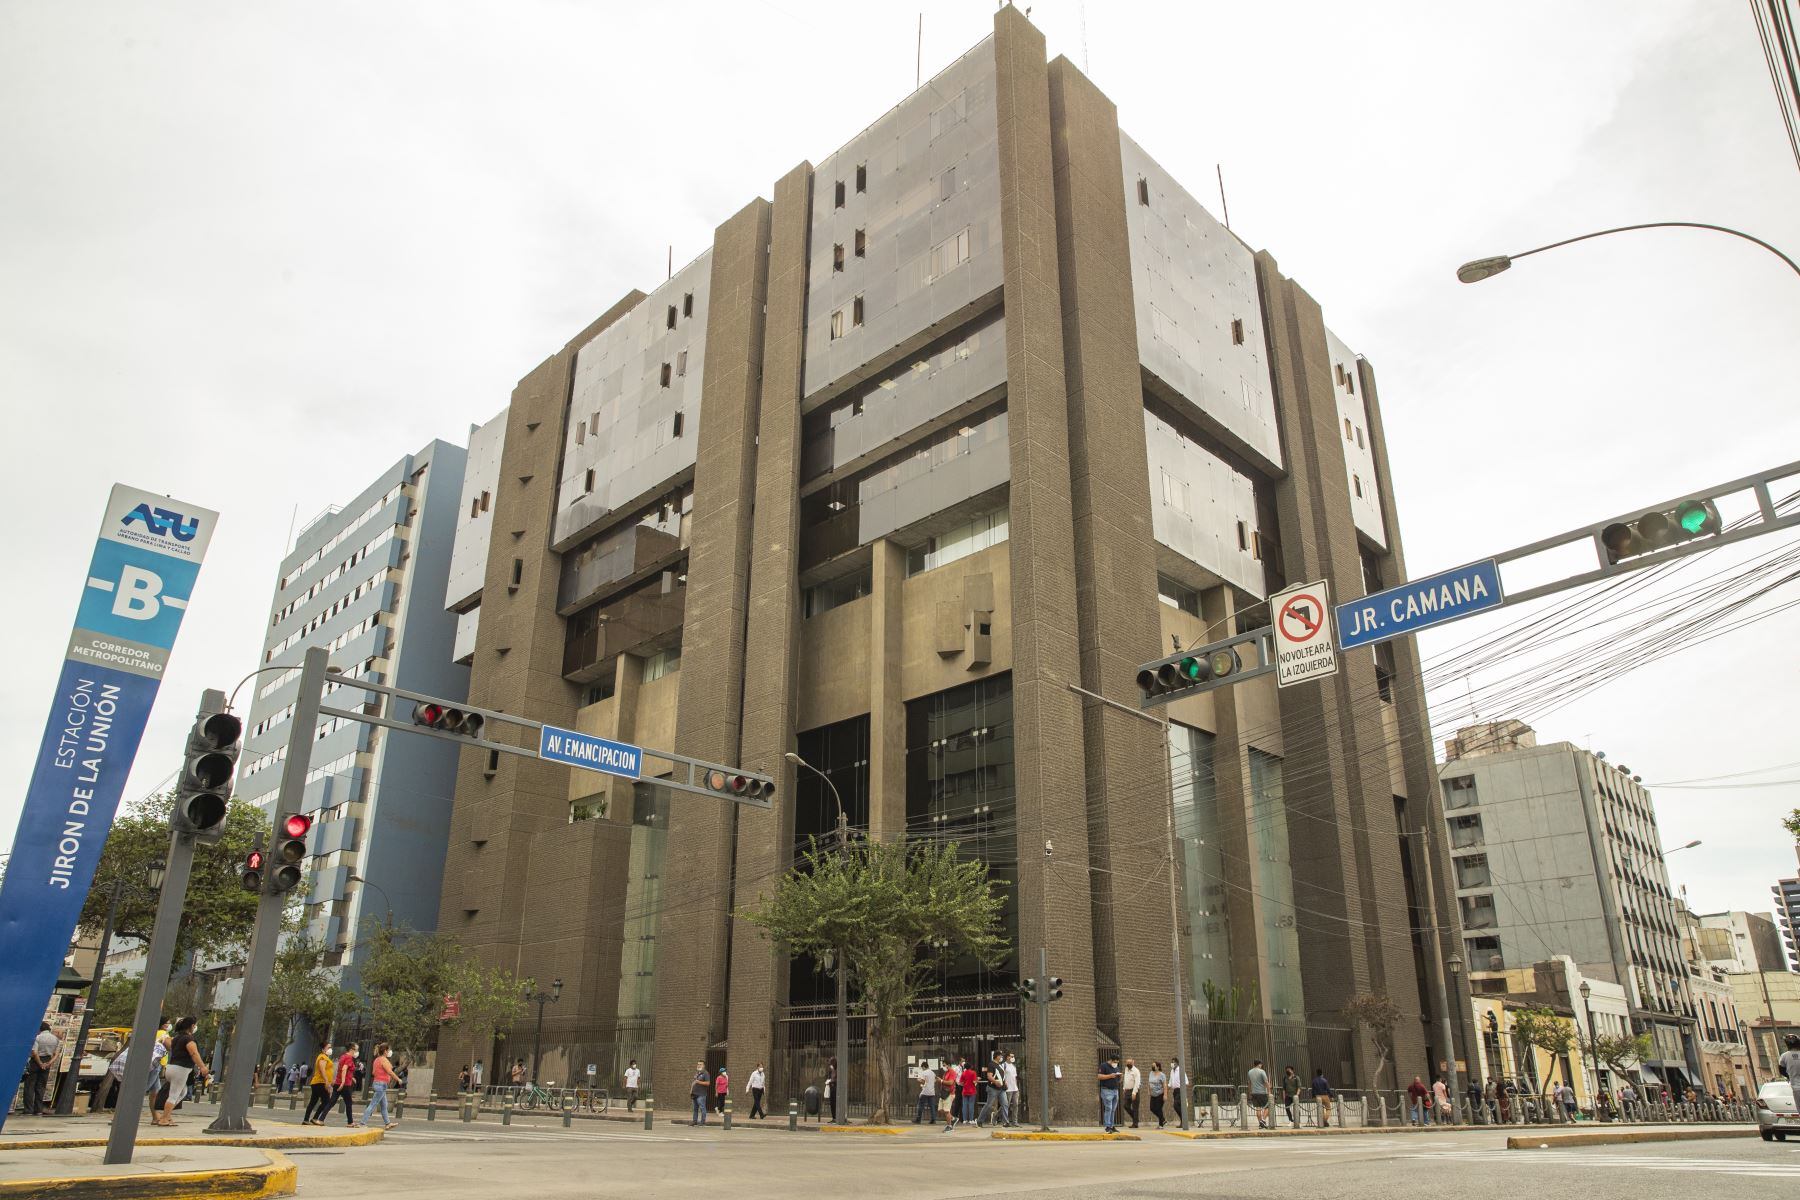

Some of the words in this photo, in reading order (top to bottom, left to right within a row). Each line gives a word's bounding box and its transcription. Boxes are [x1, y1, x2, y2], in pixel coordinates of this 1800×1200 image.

[121, 503, 199, 542] ATU
[117, 532, 140, 543] URBANO
[140, 539, 154, 547] PARA
[171, 546, 191, 556] CALLAO
[119, 528, 150, 540] AUTORIDAD
[158, 538, 191, 551] TRANSPORTE
[1350, 607, 1385, 636] JR.
[1390, 574, 1489, 623] CAMANA
[73, 645, 162, 672] METROPOLITANO
[92, 640, 150, 660] CORREDOR
[1279, 652, 1291, 664] NO
[1291, 643, 1325, 661] VOLTEAR
[1325, 641, 1332, 653] A
[1281, 667, 1292, 678] LA
[1292, 656, 1334, 676] IZQUIERDA
[54, 678, 95, 769] ESTACIÓN
[86, 684, 121, 752] UNIÓN
[547, 734, 562, 754] AV.
[565, 738, 636, 771] EMANCIPACION
[78, 758, 102, 783] LA
[69, 787, 94, 816] DE
[49, 821, 85, 889] JIRON
